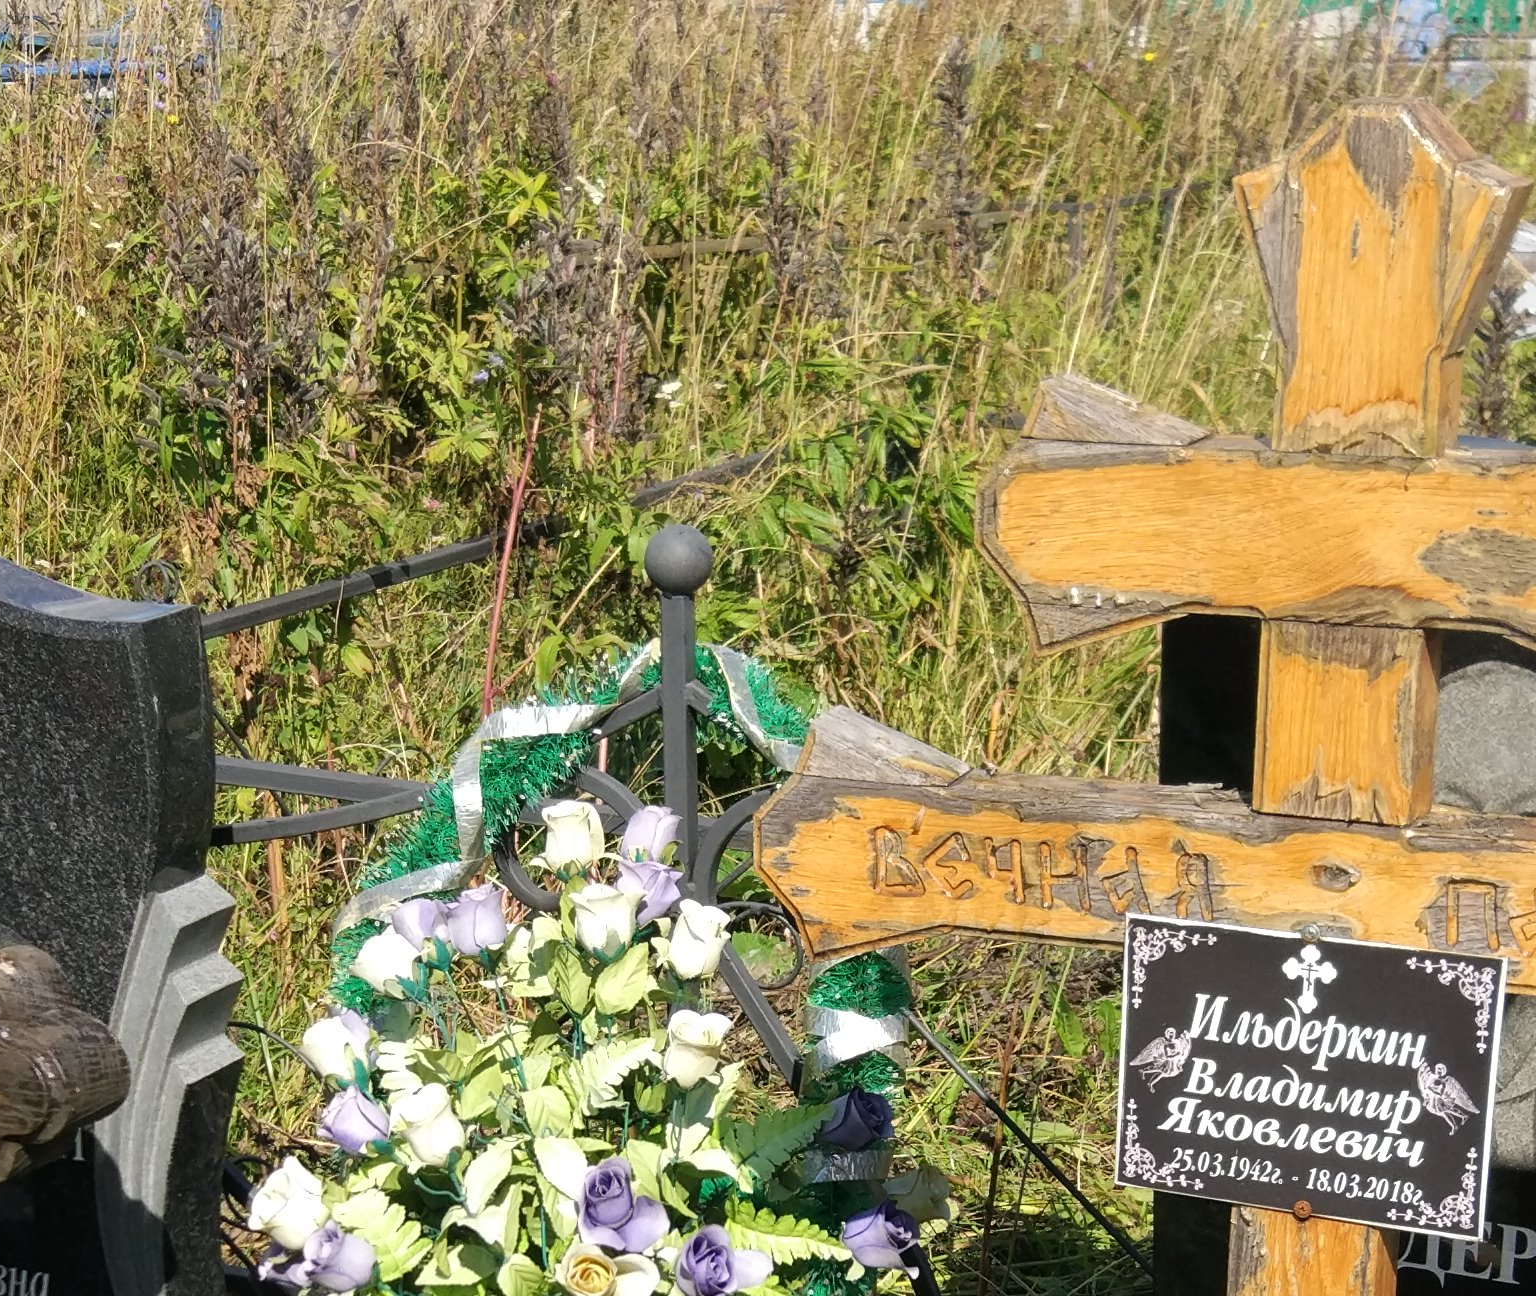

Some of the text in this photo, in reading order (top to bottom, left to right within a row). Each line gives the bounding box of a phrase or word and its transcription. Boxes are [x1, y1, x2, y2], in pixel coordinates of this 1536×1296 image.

[1186, 992, 1428, 1072] Ильдеркин
[1156, 1096, 1426, 1168] Яковлевич
[1183, 1057, 1422, 1136] Владимир
